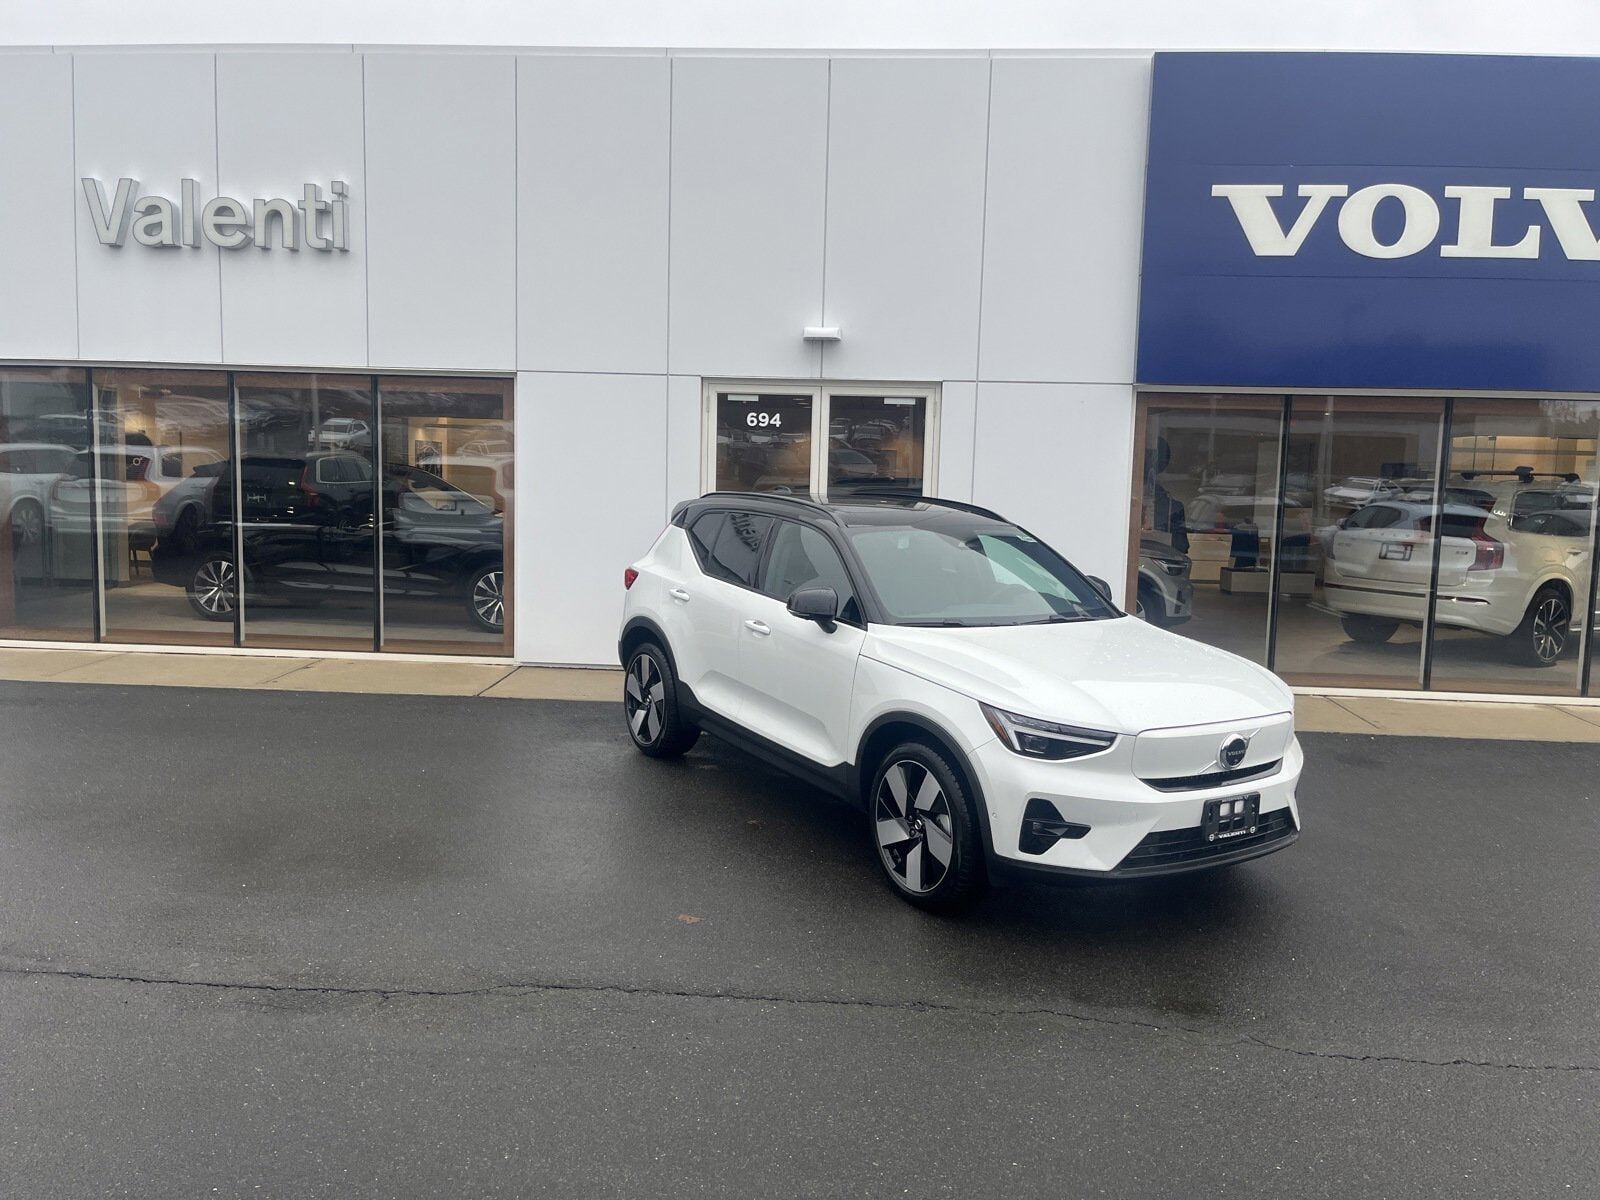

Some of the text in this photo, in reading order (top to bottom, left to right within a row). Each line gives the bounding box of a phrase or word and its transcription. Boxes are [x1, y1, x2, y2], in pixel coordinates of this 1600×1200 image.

[81, 177, 349, 252] Valenti
[746, 412, 782, 428] 694
[1218, 830, 1246, 839] VALENTI
